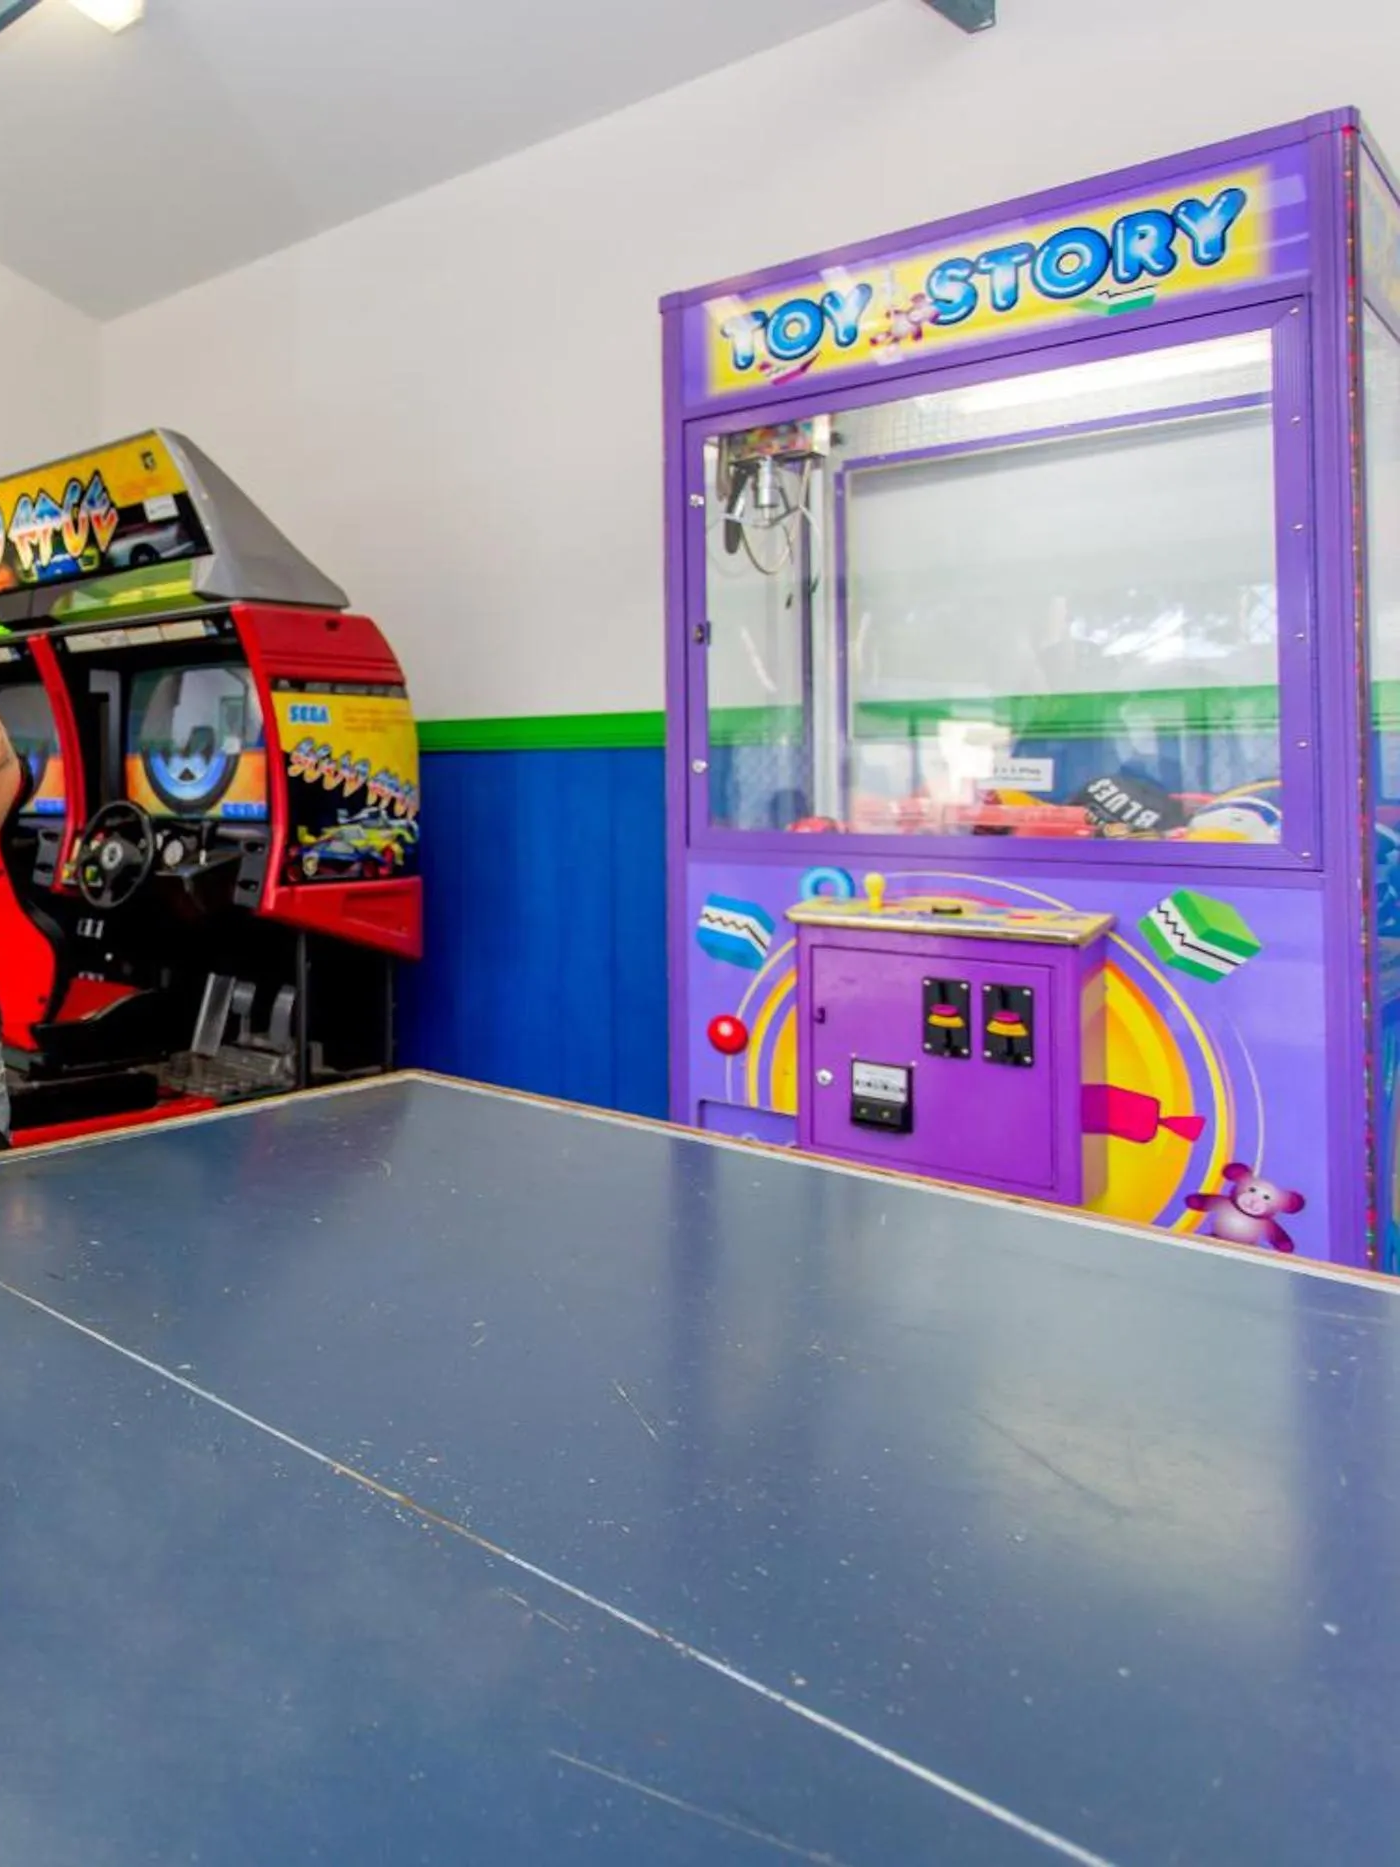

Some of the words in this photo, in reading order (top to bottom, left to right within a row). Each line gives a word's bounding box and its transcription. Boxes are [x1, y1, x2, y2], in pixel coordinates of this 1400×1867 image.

[720, 281, 874, 371] TOY
[925, 187, 1248, 326] STORY
[289, 704, 330, 724] SEGA
[1087, 778, 1160, 828] BLUES
